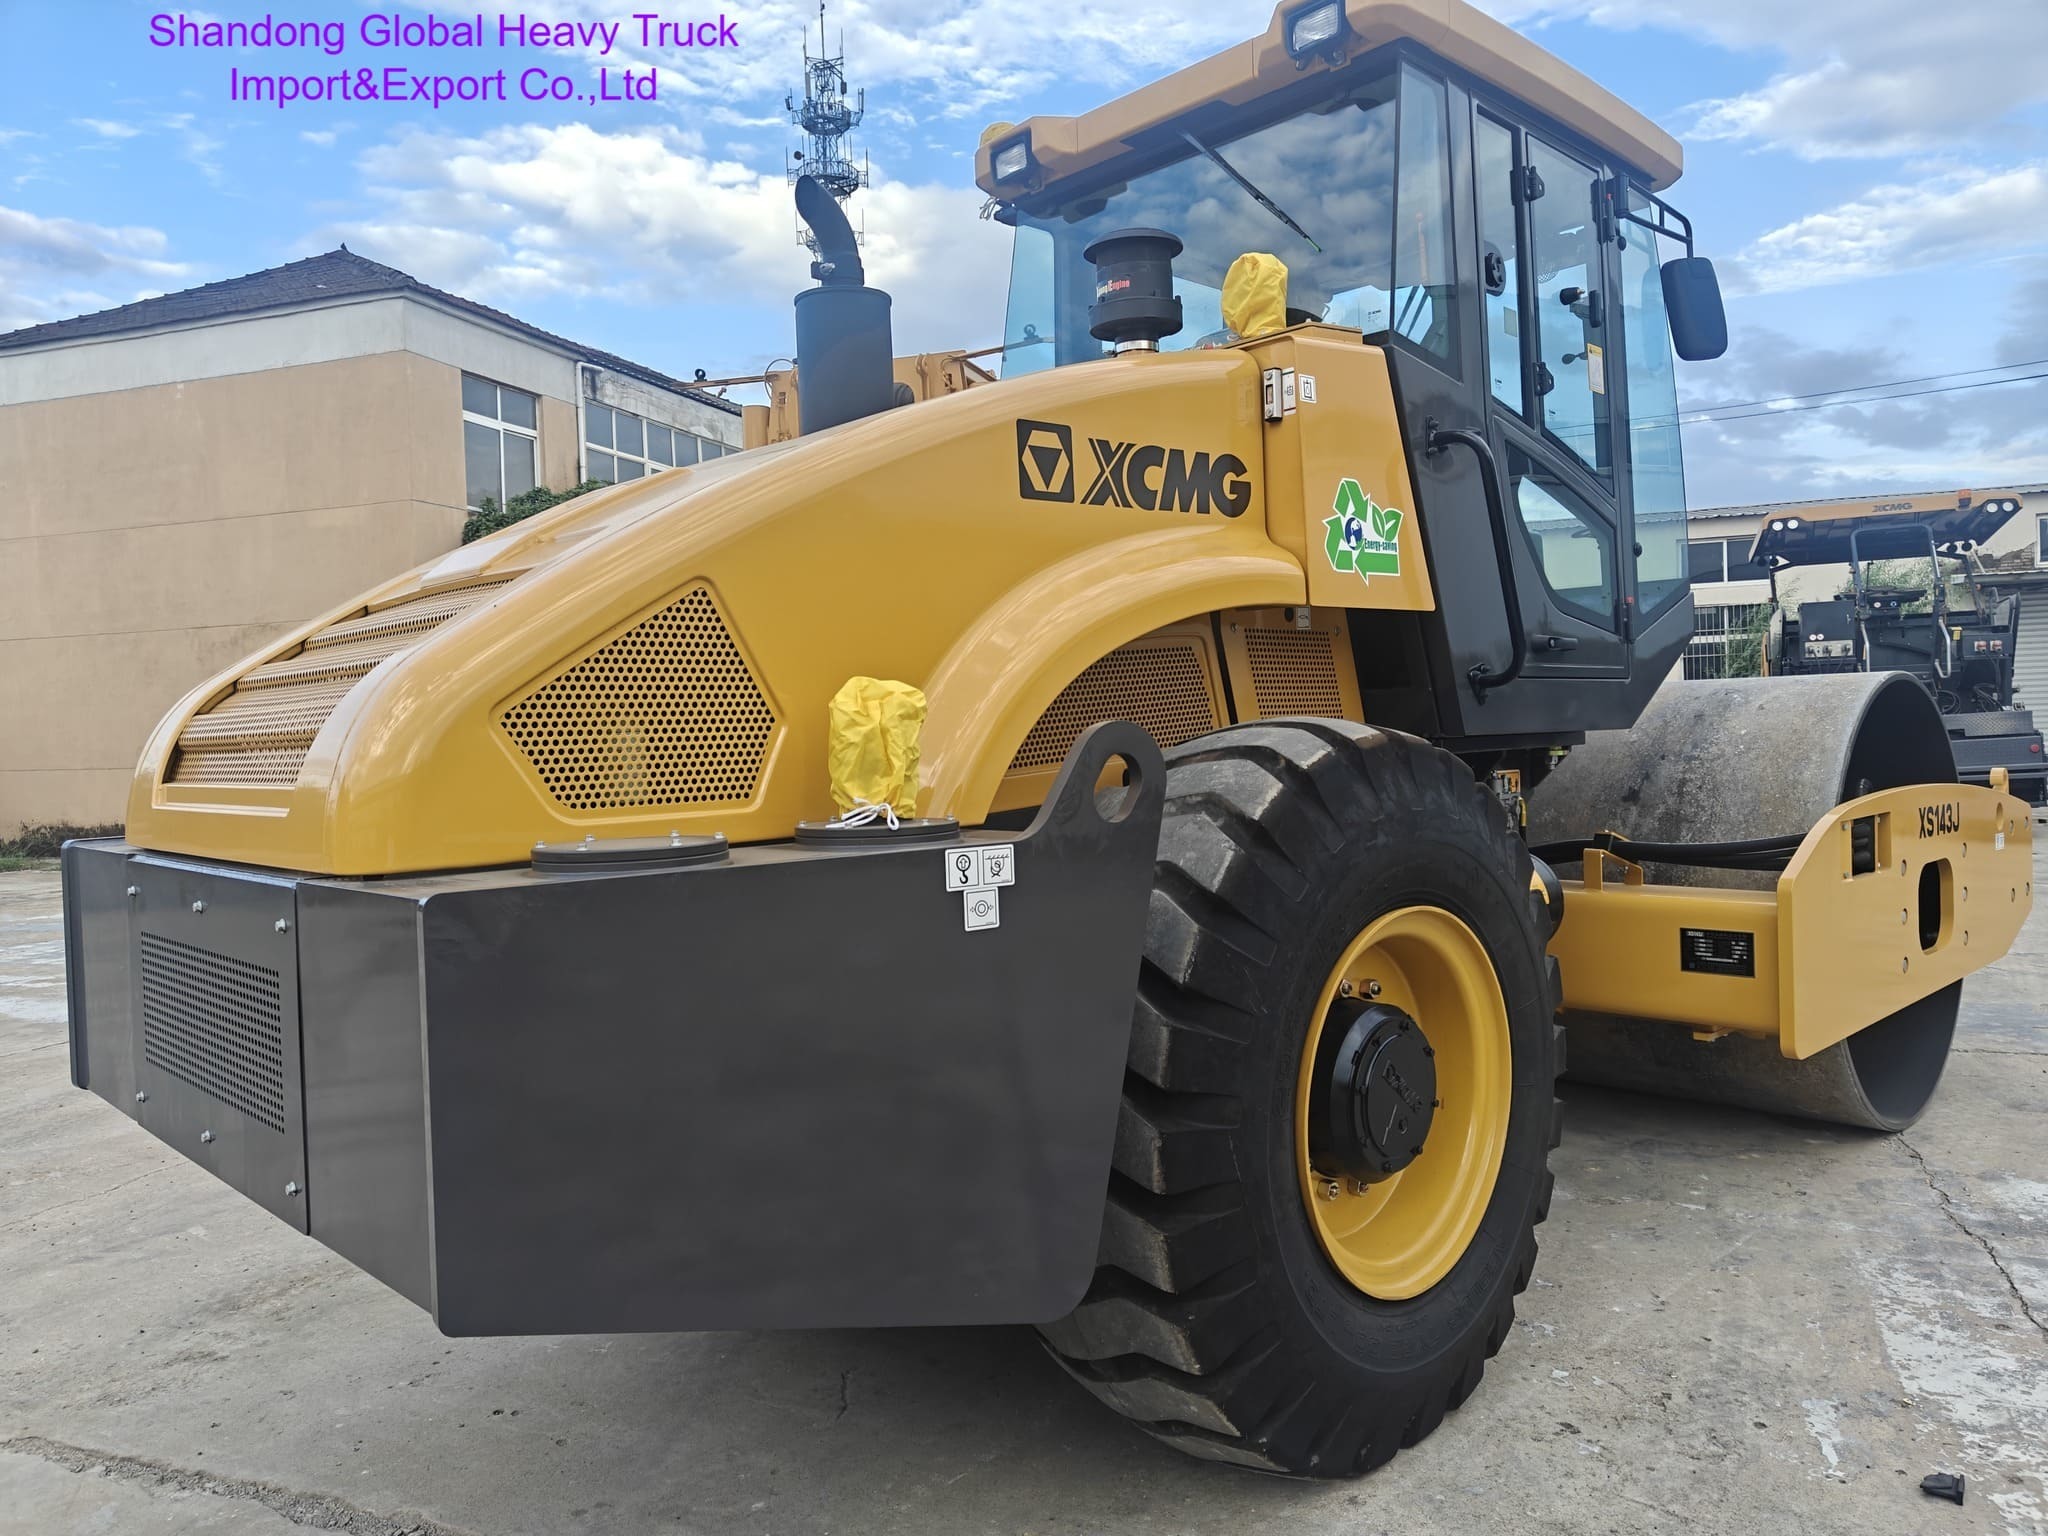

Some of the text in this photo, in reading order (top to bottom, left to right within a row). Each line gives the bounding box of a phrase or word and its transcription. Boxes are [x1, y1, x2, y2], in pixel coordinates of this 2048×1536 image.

[1080, 437, 1251, 518] XCMG
[1872, 502, 1913, 513] XCMG
[1918, 802, 1960, 839] XS143J
